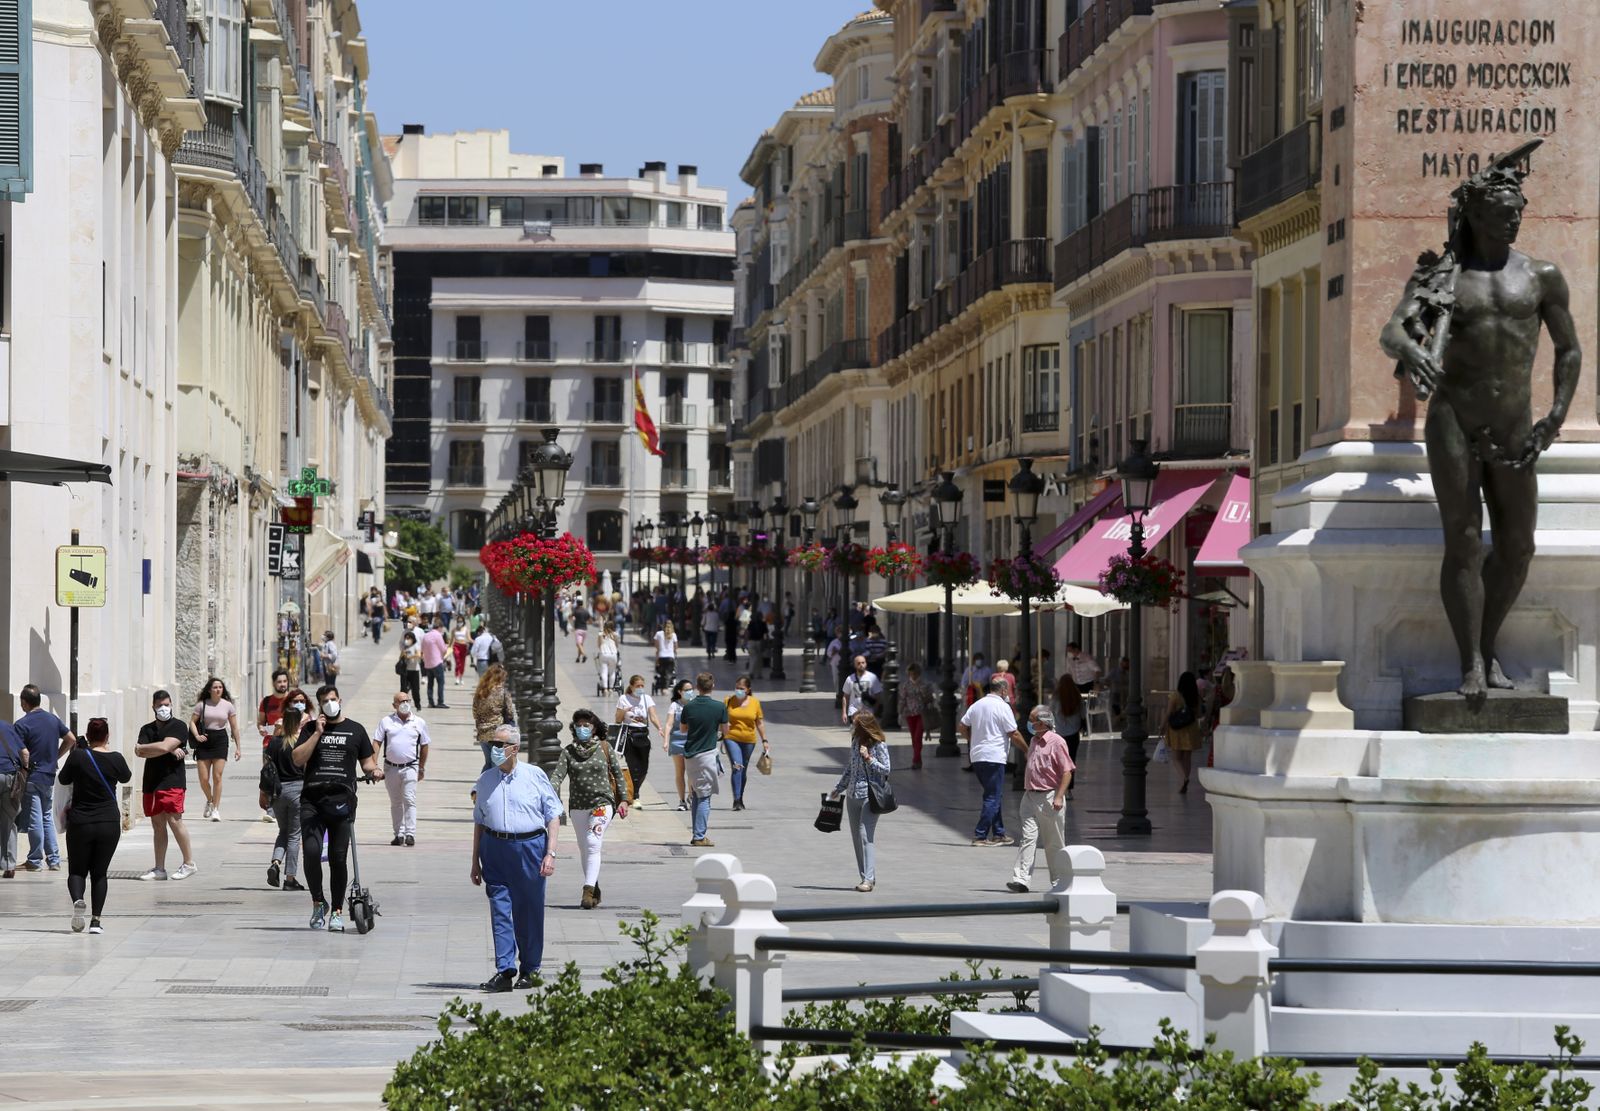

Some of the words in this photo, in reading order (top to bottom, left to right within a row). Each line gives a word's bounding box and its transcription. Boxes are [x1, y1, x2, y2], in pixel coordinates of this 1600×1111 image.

[1402, 19, 1555, 46] INAUGURACION
[1397, 63, 1457, 89] ENERO
[1467, 62, 1571, 89] MDCCCXCIX
[1397, 107, 1556, 135] RESTAURACION
[1422, 152, 1479, 178] MAYO
